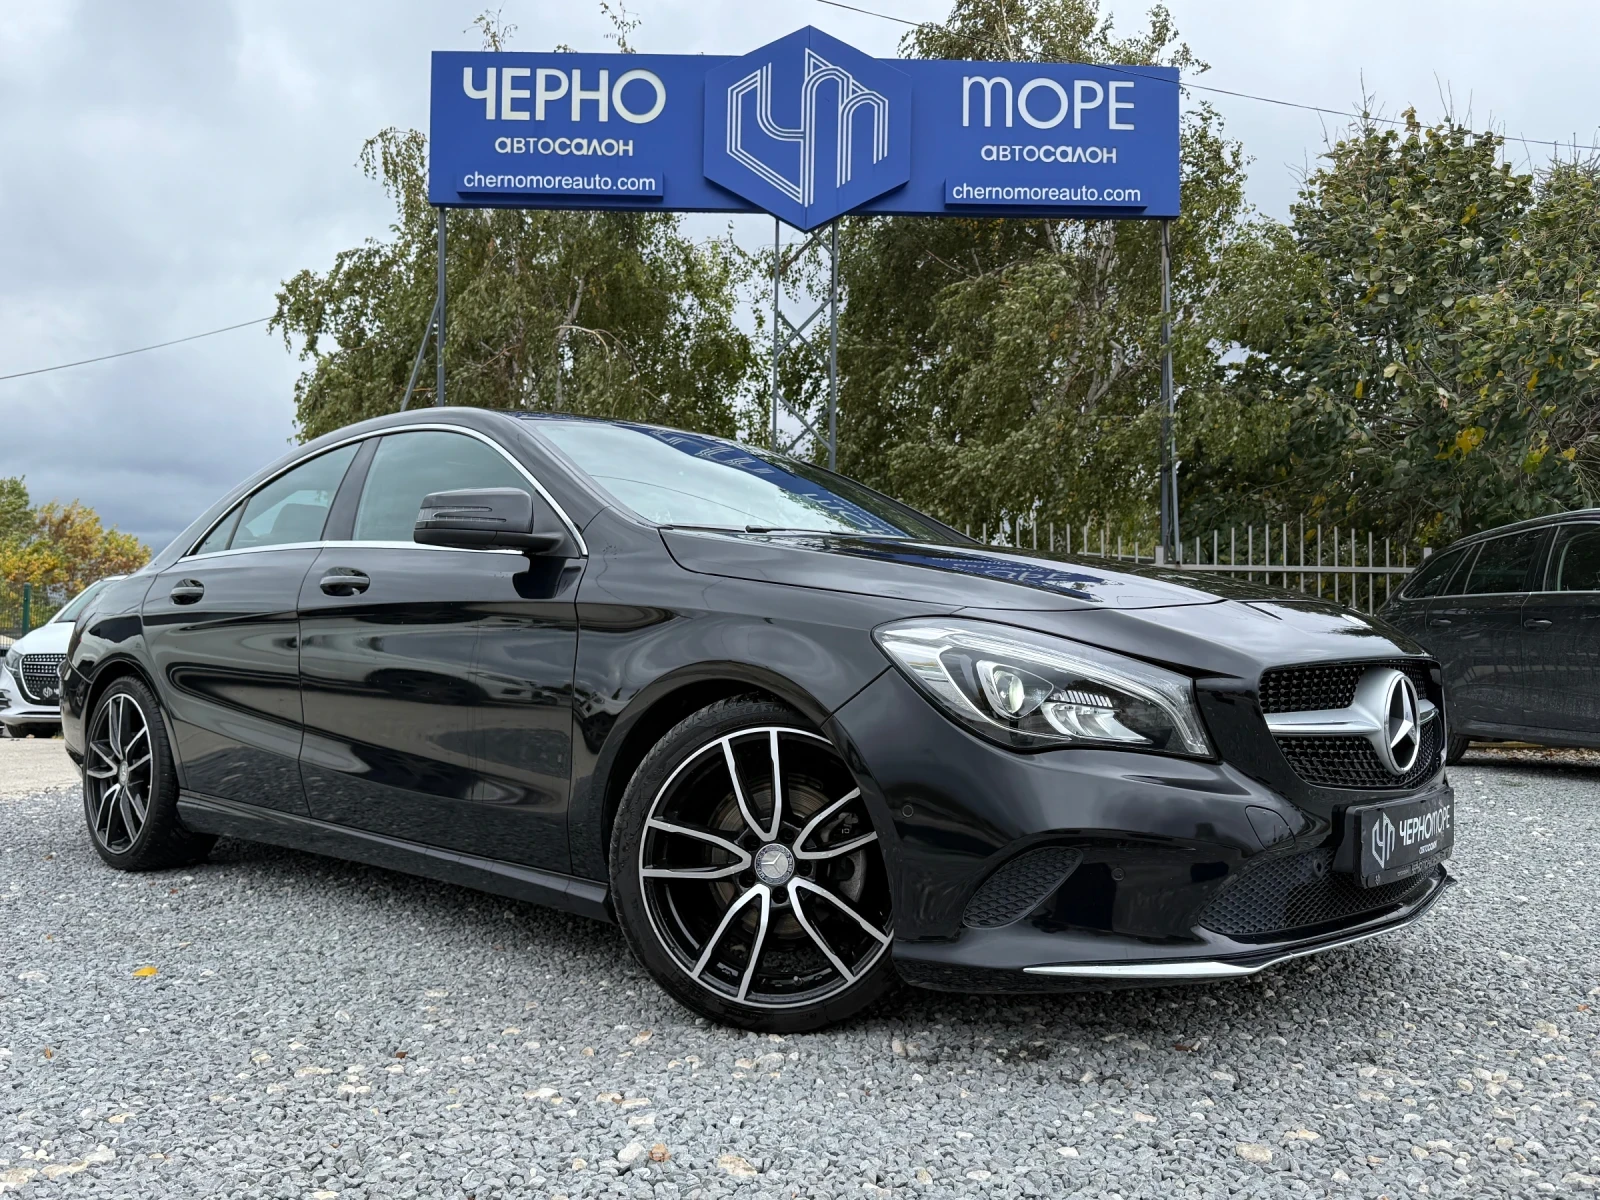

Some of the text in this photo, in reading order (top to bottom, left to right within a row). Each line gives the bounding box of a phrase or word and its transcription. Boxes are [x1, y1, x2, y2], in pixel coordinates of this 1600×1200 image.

[463, 67, 667, 124] ЧЕРНО
[495, 137, 633, 157] автосалон
[981, 145, 1117, 164] автосалон
[463, 171, 656, 191] chernomoreauto.com
[952, 183, 1141, 202] chernomoreauto.com
